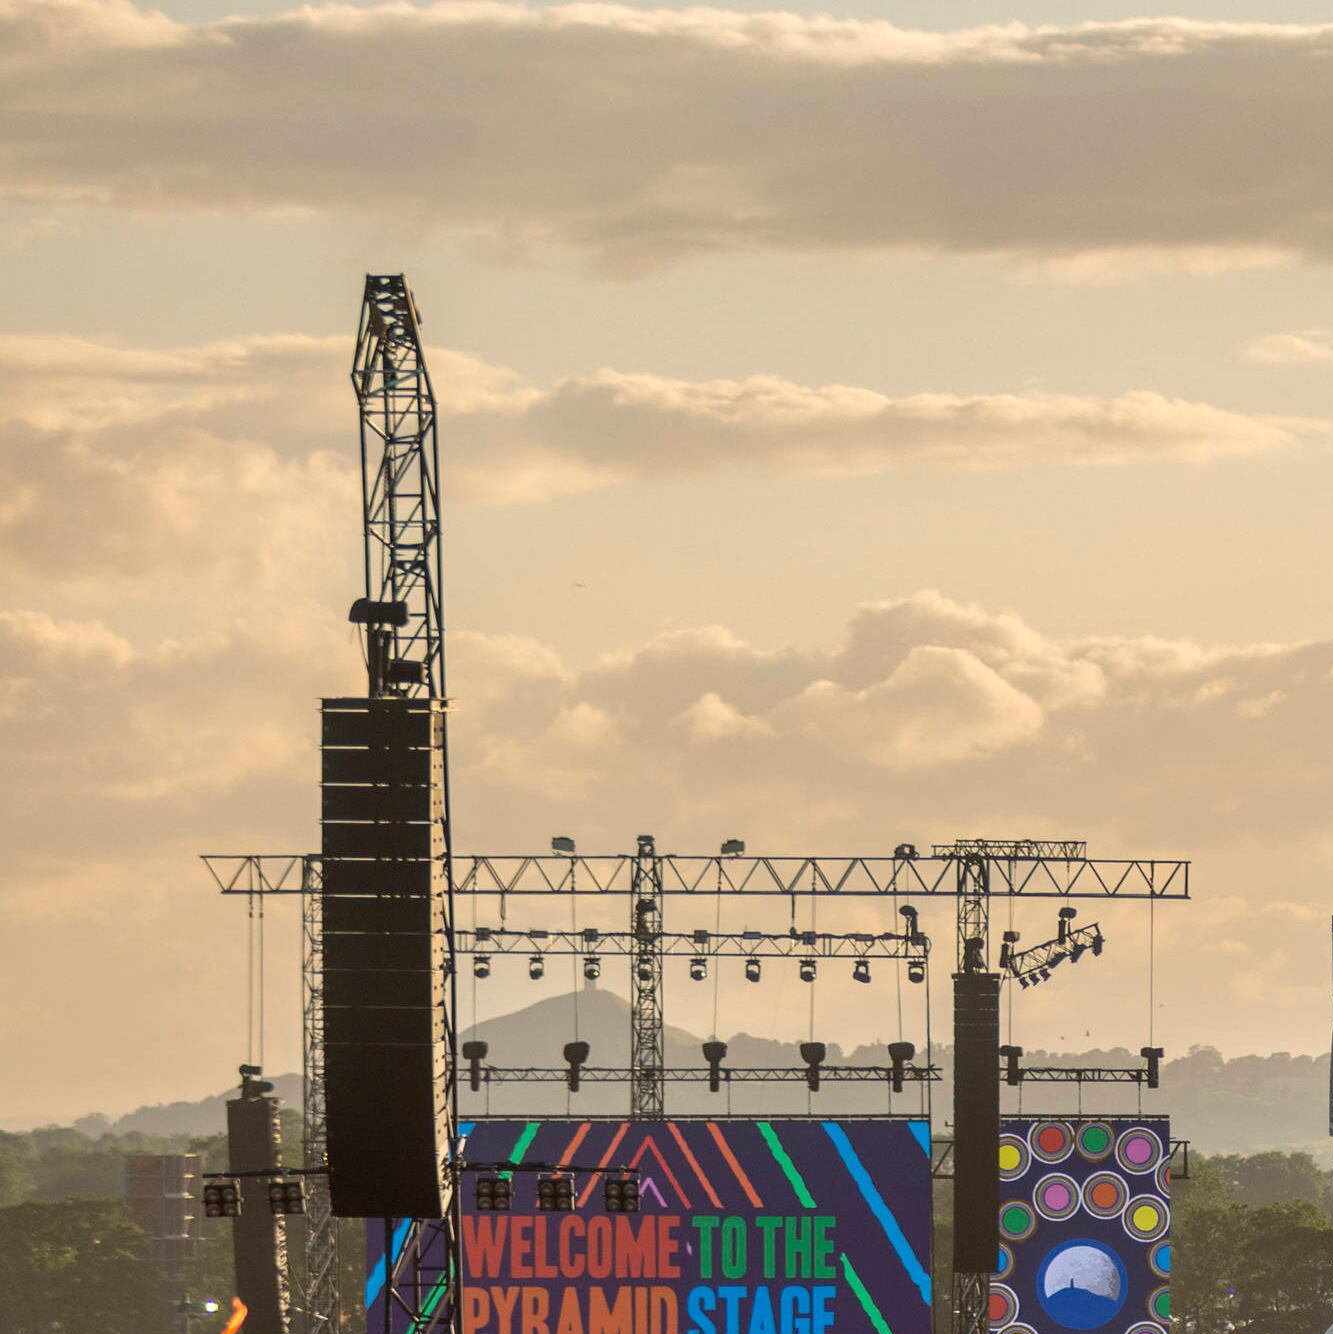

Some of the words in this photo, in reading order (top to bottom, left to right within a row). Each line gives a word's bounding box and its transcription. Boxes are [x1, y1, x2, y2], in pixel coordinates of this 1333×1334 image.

[462, 1215, 681, 1279] WELCOME
[692, 1215, 748, 1279] TO
[756, 1215, 837, 1279] THE
